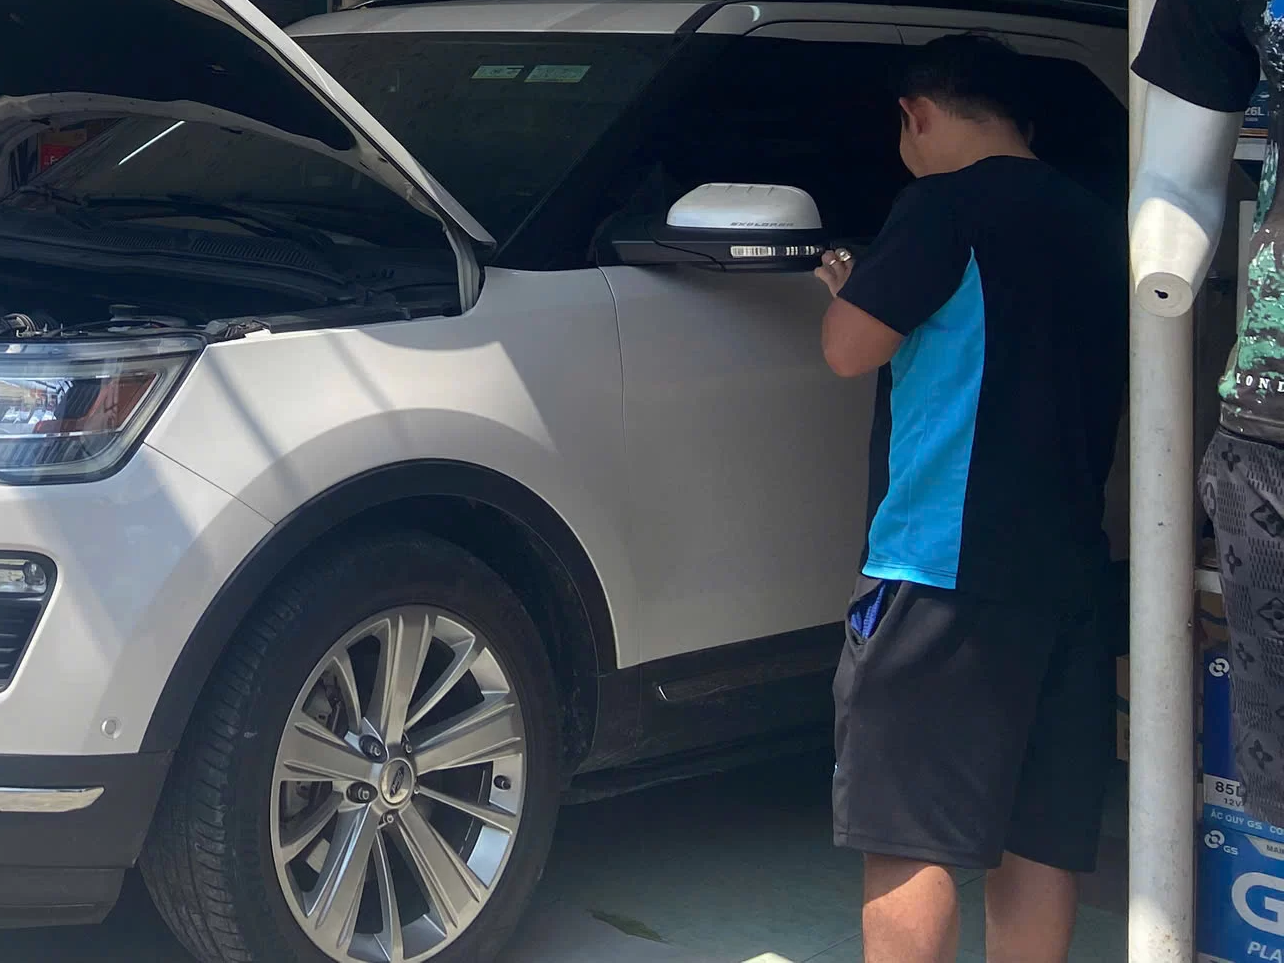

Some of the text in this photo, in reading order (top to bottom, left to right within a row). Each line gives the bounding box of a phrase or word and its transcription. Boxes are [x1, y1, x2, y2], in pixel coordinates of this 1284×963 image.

[1225, 814, 1244, 826] QUY
[1247, 820, 1263, 830] GS
[1223, 845, 1239, 856] GS
